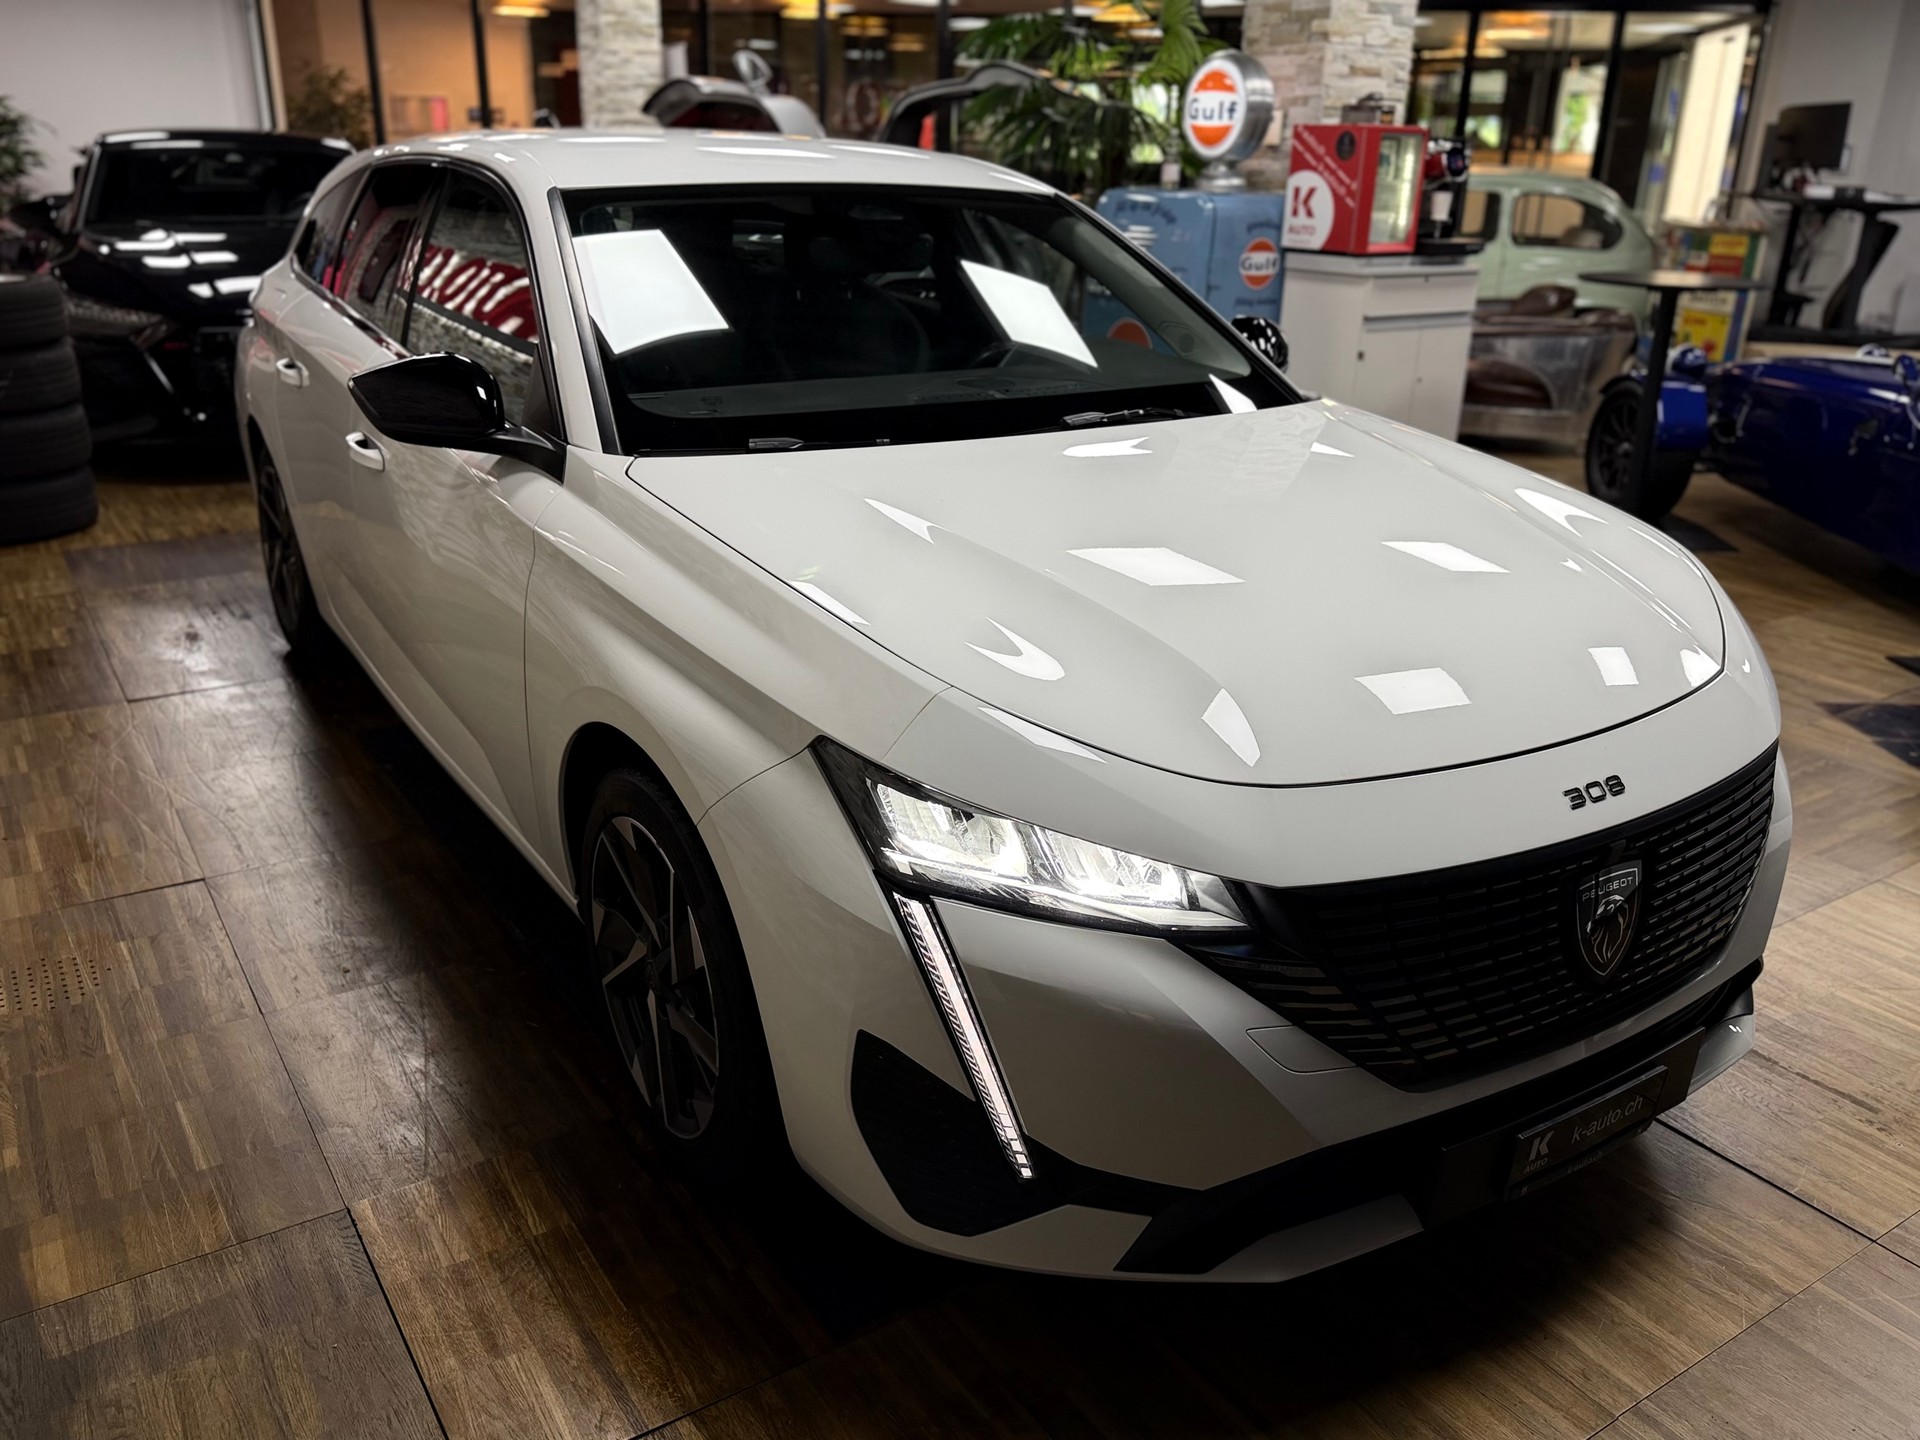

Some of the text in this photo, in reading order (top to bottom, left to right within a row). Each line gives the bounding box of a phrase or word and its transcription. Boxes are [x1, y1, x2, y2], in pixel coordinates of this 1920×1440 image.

[1189, 98, 1238, 120] Gulf
[1291, 186, 1317, 218] K
[1288, 225, 1316, 236] AUTO
[1241, 256, 1278, 272] Gulf
[1563, 775, 1625, 809] 308
[1582, 877, 1633, 900] PEUGEOT
[1572, 1096, 1643, 1143] k-auto.ch
[1528, 1130, 1554, 1161] K
[1523, 1157, 1548, 1174] AUTO
